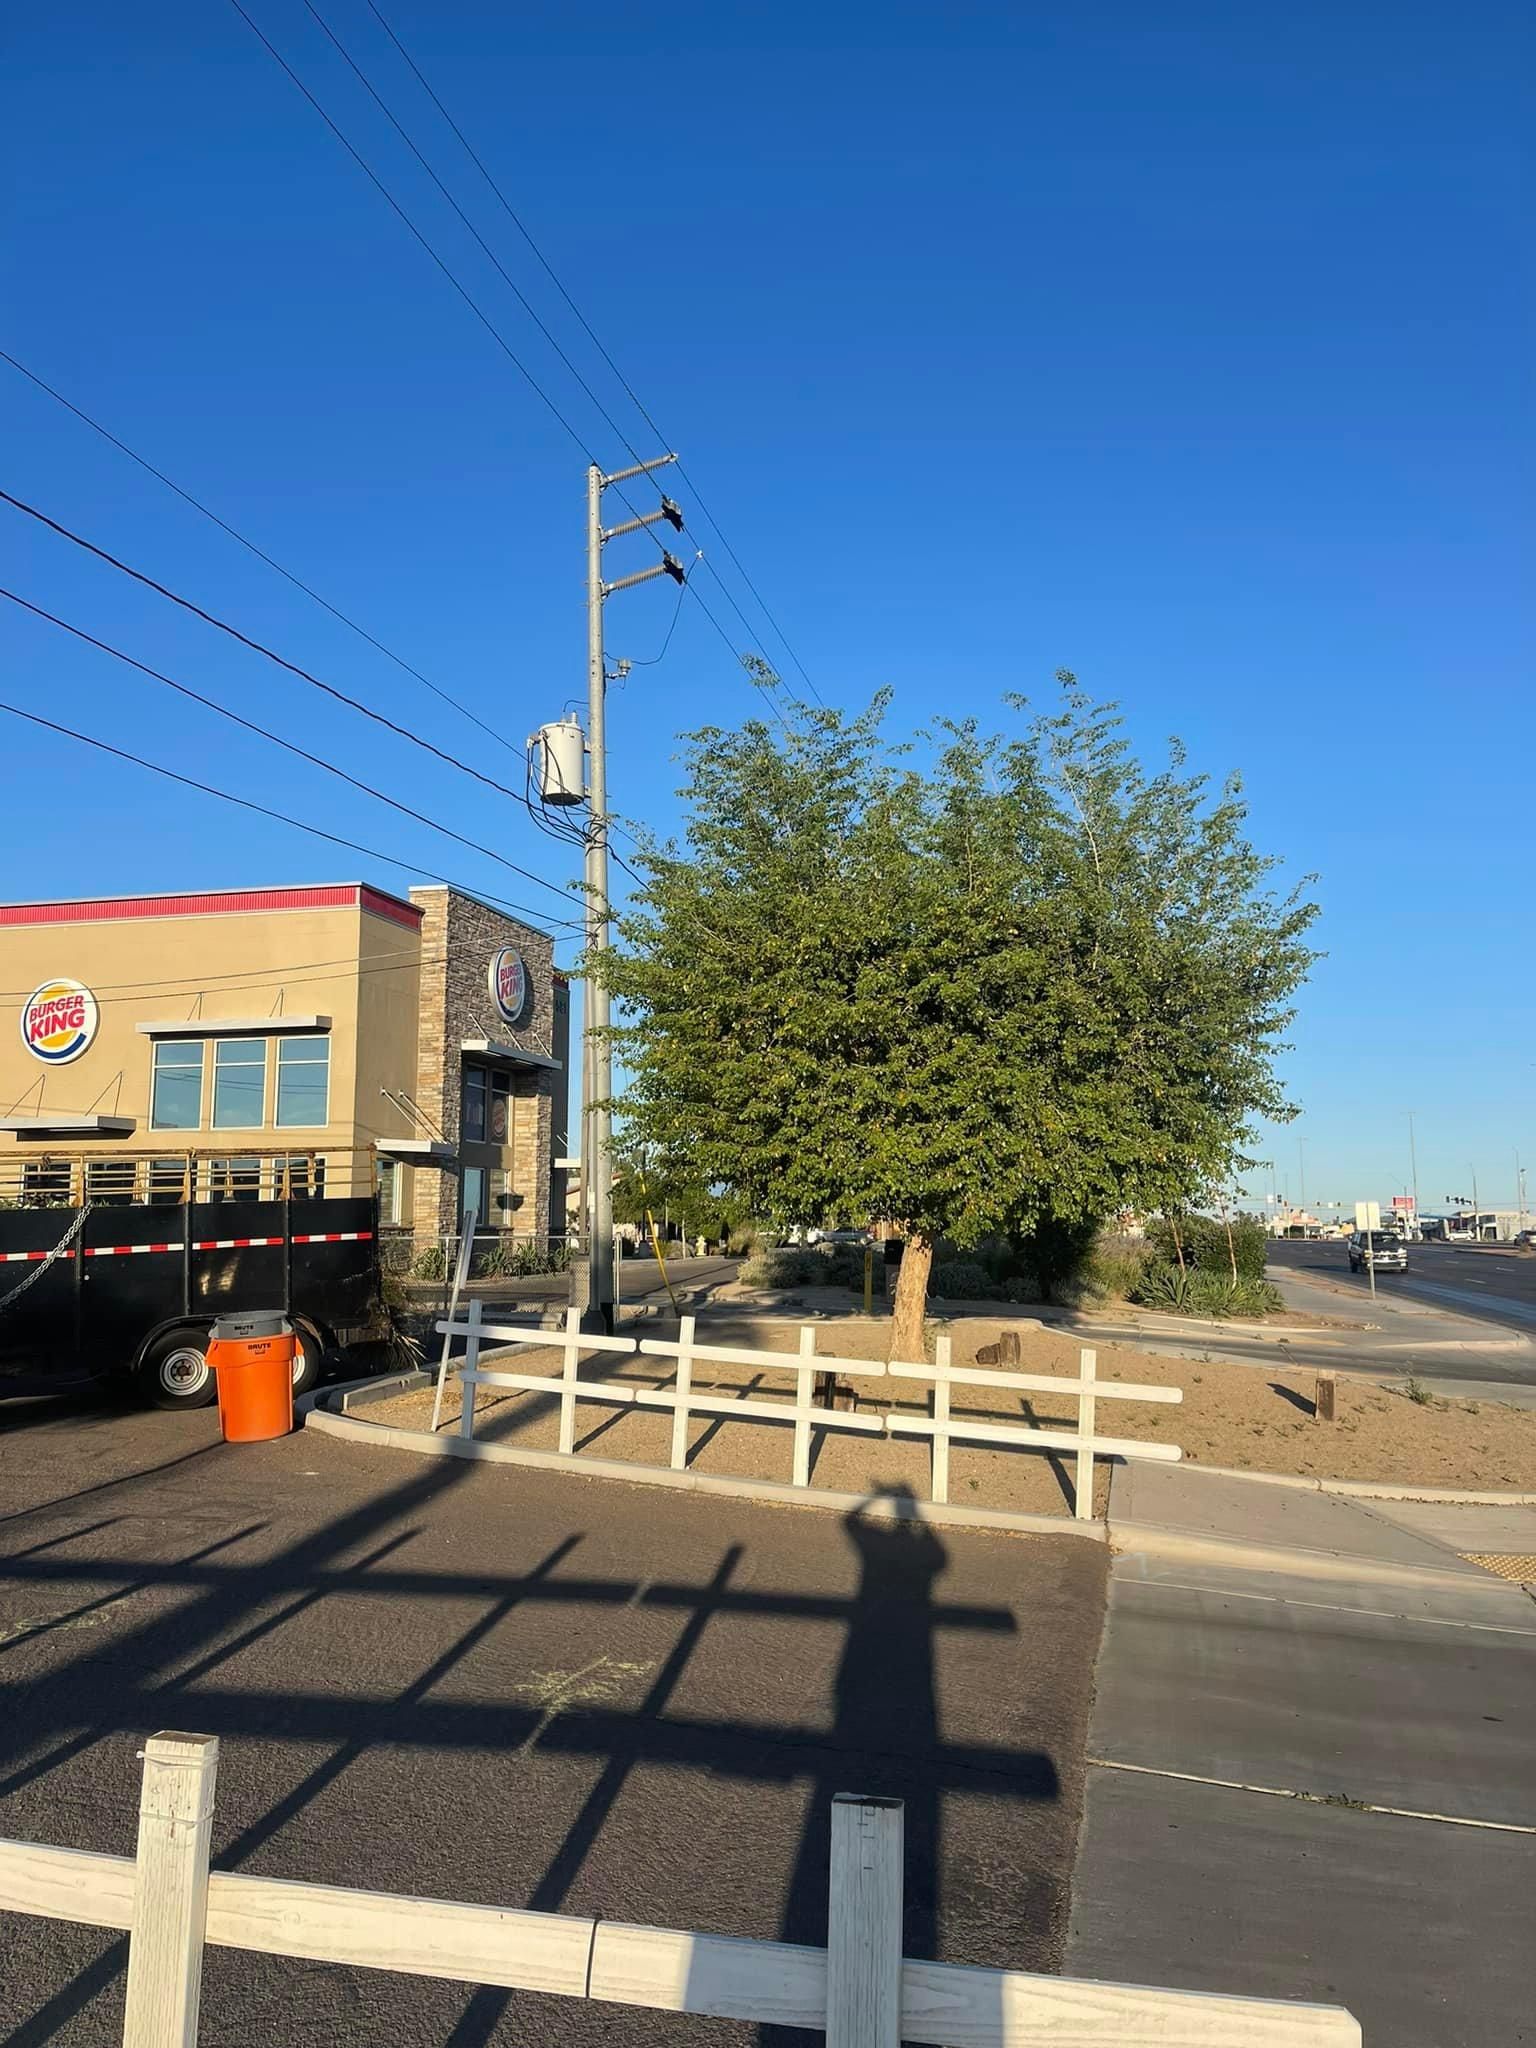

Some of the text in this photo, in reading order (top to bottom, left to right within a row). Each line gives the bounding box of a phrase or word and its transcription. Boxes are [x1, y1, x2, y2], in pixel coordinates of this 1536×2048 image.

[501, 976, 523, 999] KING
[29, 995, 84, 1023] BURGER
[30, 1008, 85, 1042] KING
[247, 1342, 271, 1350] BRUTE
